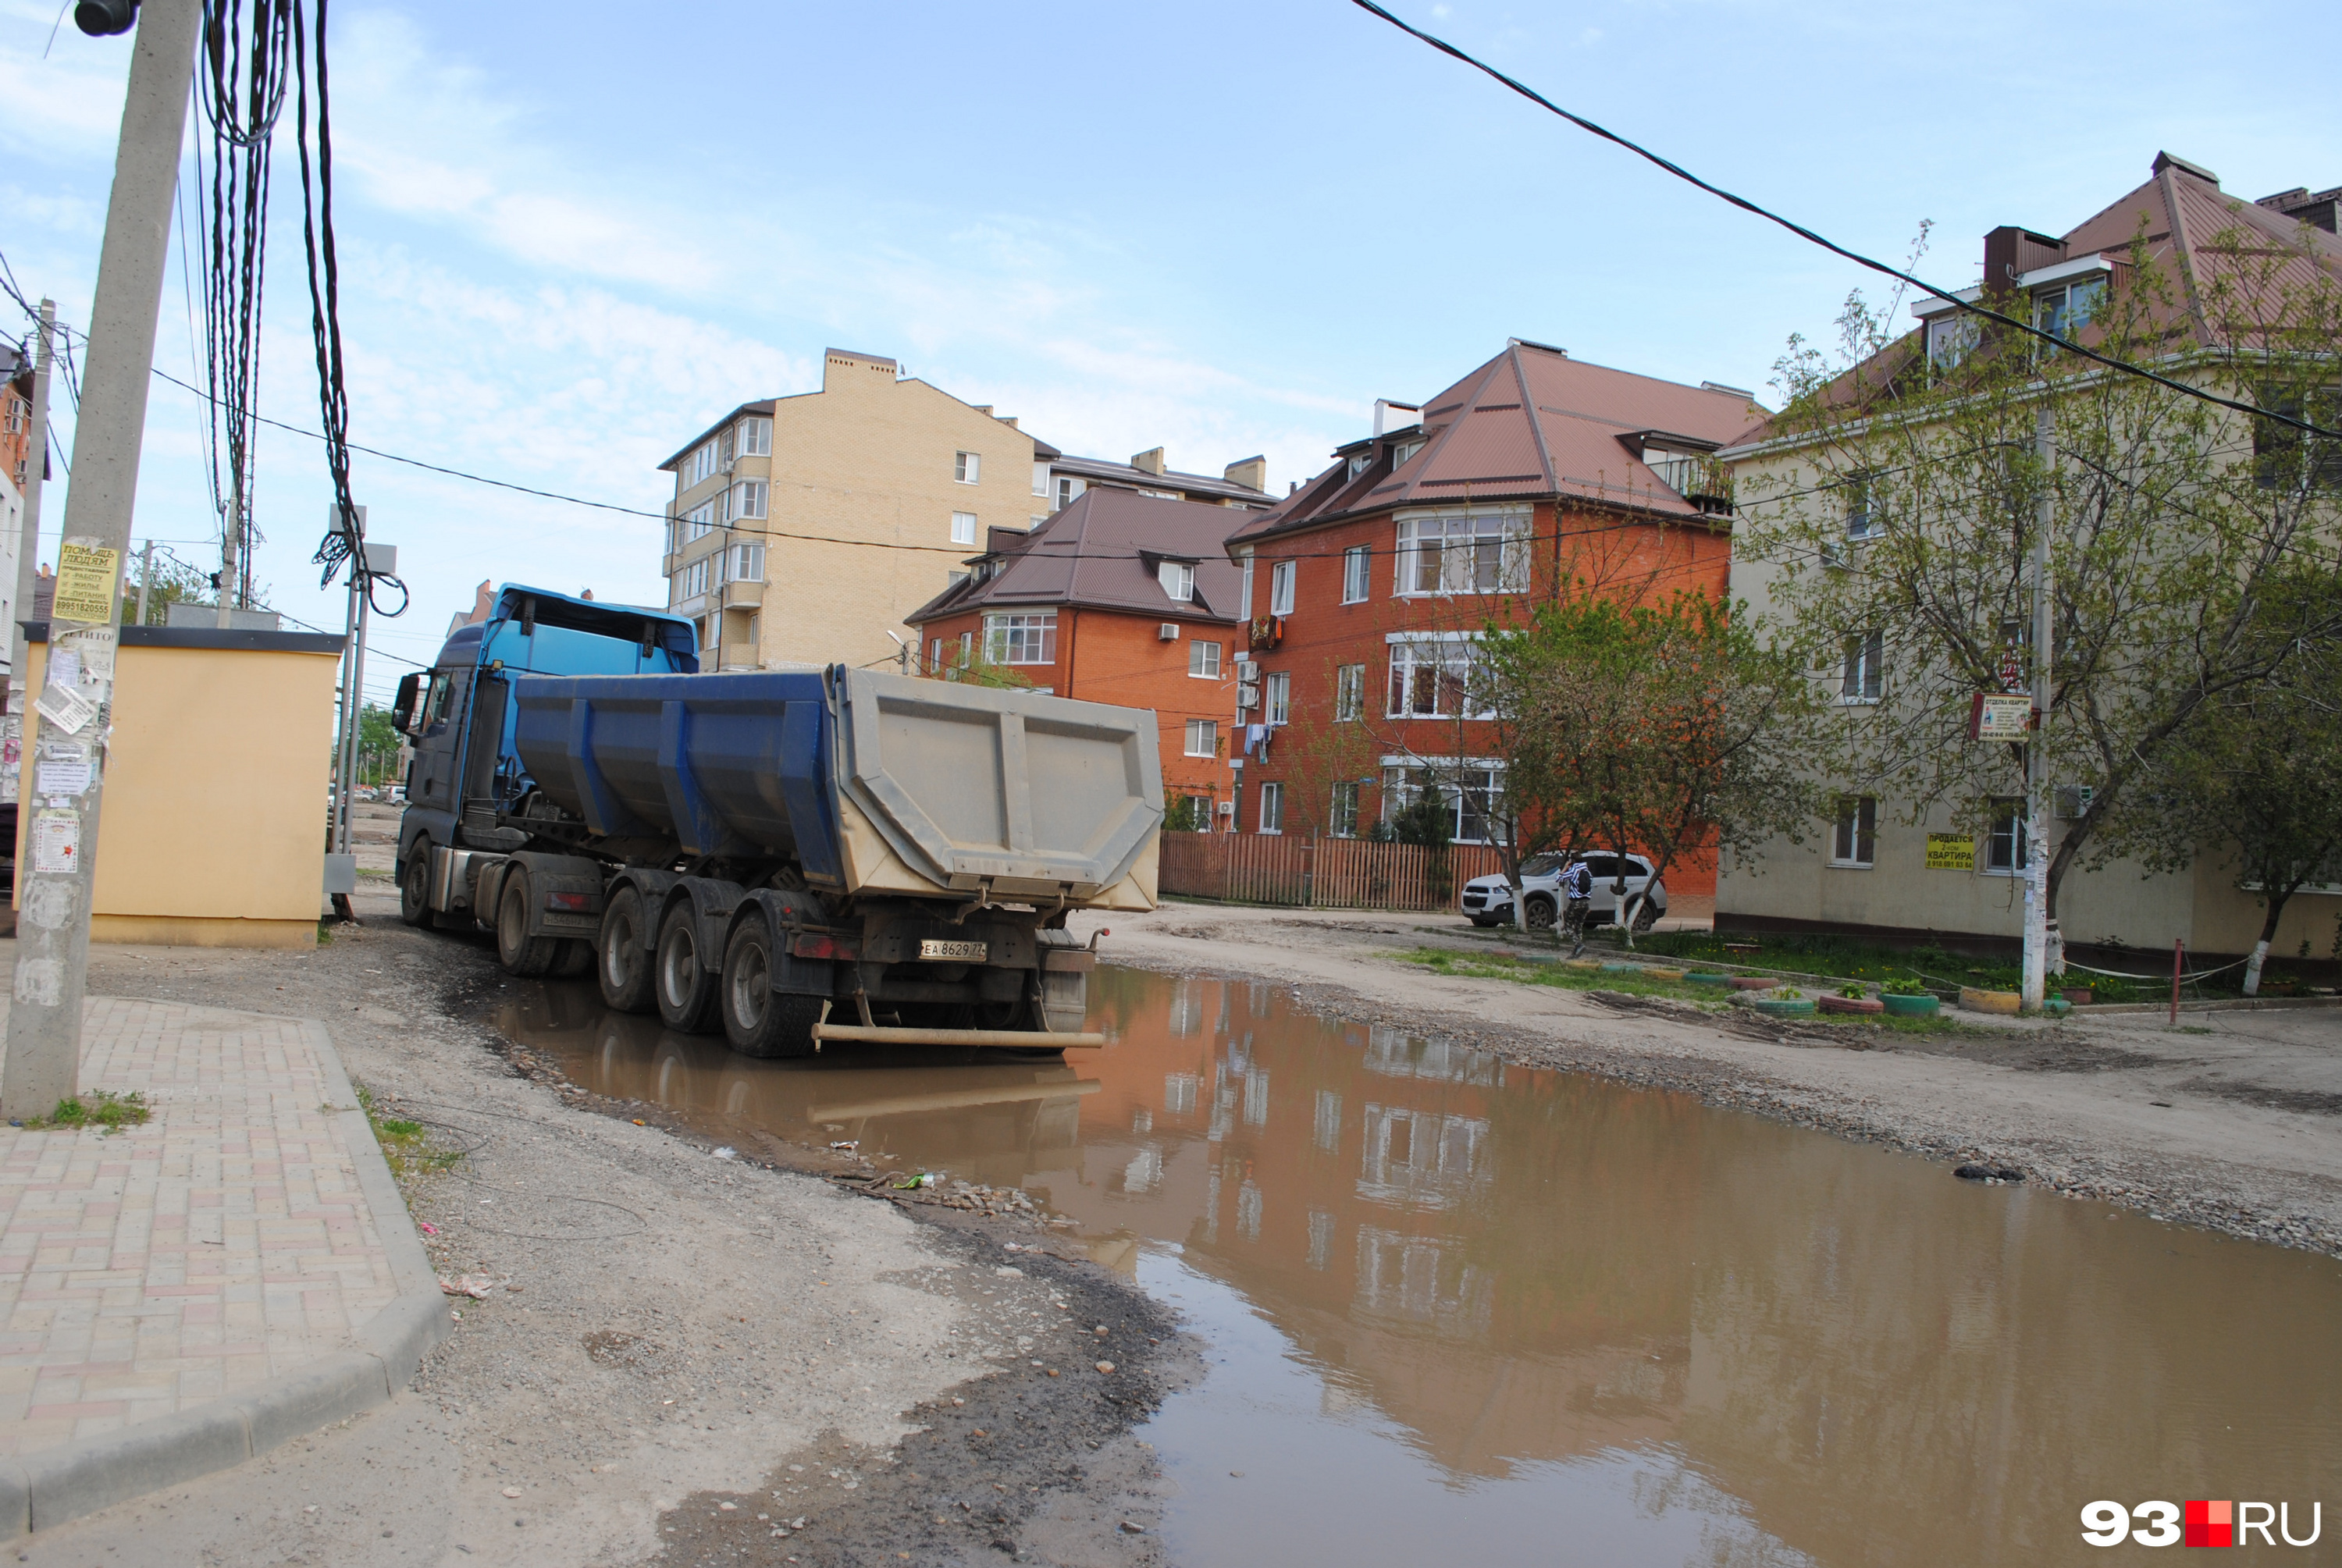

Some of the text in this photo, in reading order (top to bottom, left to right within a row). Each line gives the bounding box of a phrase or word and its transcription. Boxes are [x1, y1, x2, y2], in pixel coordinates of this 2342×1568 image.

[64, 555, 109, 566] ЛЮДЯМ
[62, 565, 111, 574] ПРЕДОСТАВЛЯЕМ
[55, 601, 109, 614] 89951820555
[55, 609, 109, 620] КРУГЛОСУТОЧНО
[1929, 835, 1974, 844] ПРОДАЕТСЯ
[1927, 851, 1973, 861] КВАРТИРА
[941, 943, 970, 956] 8629
[973, 944, 983, 953] 77
